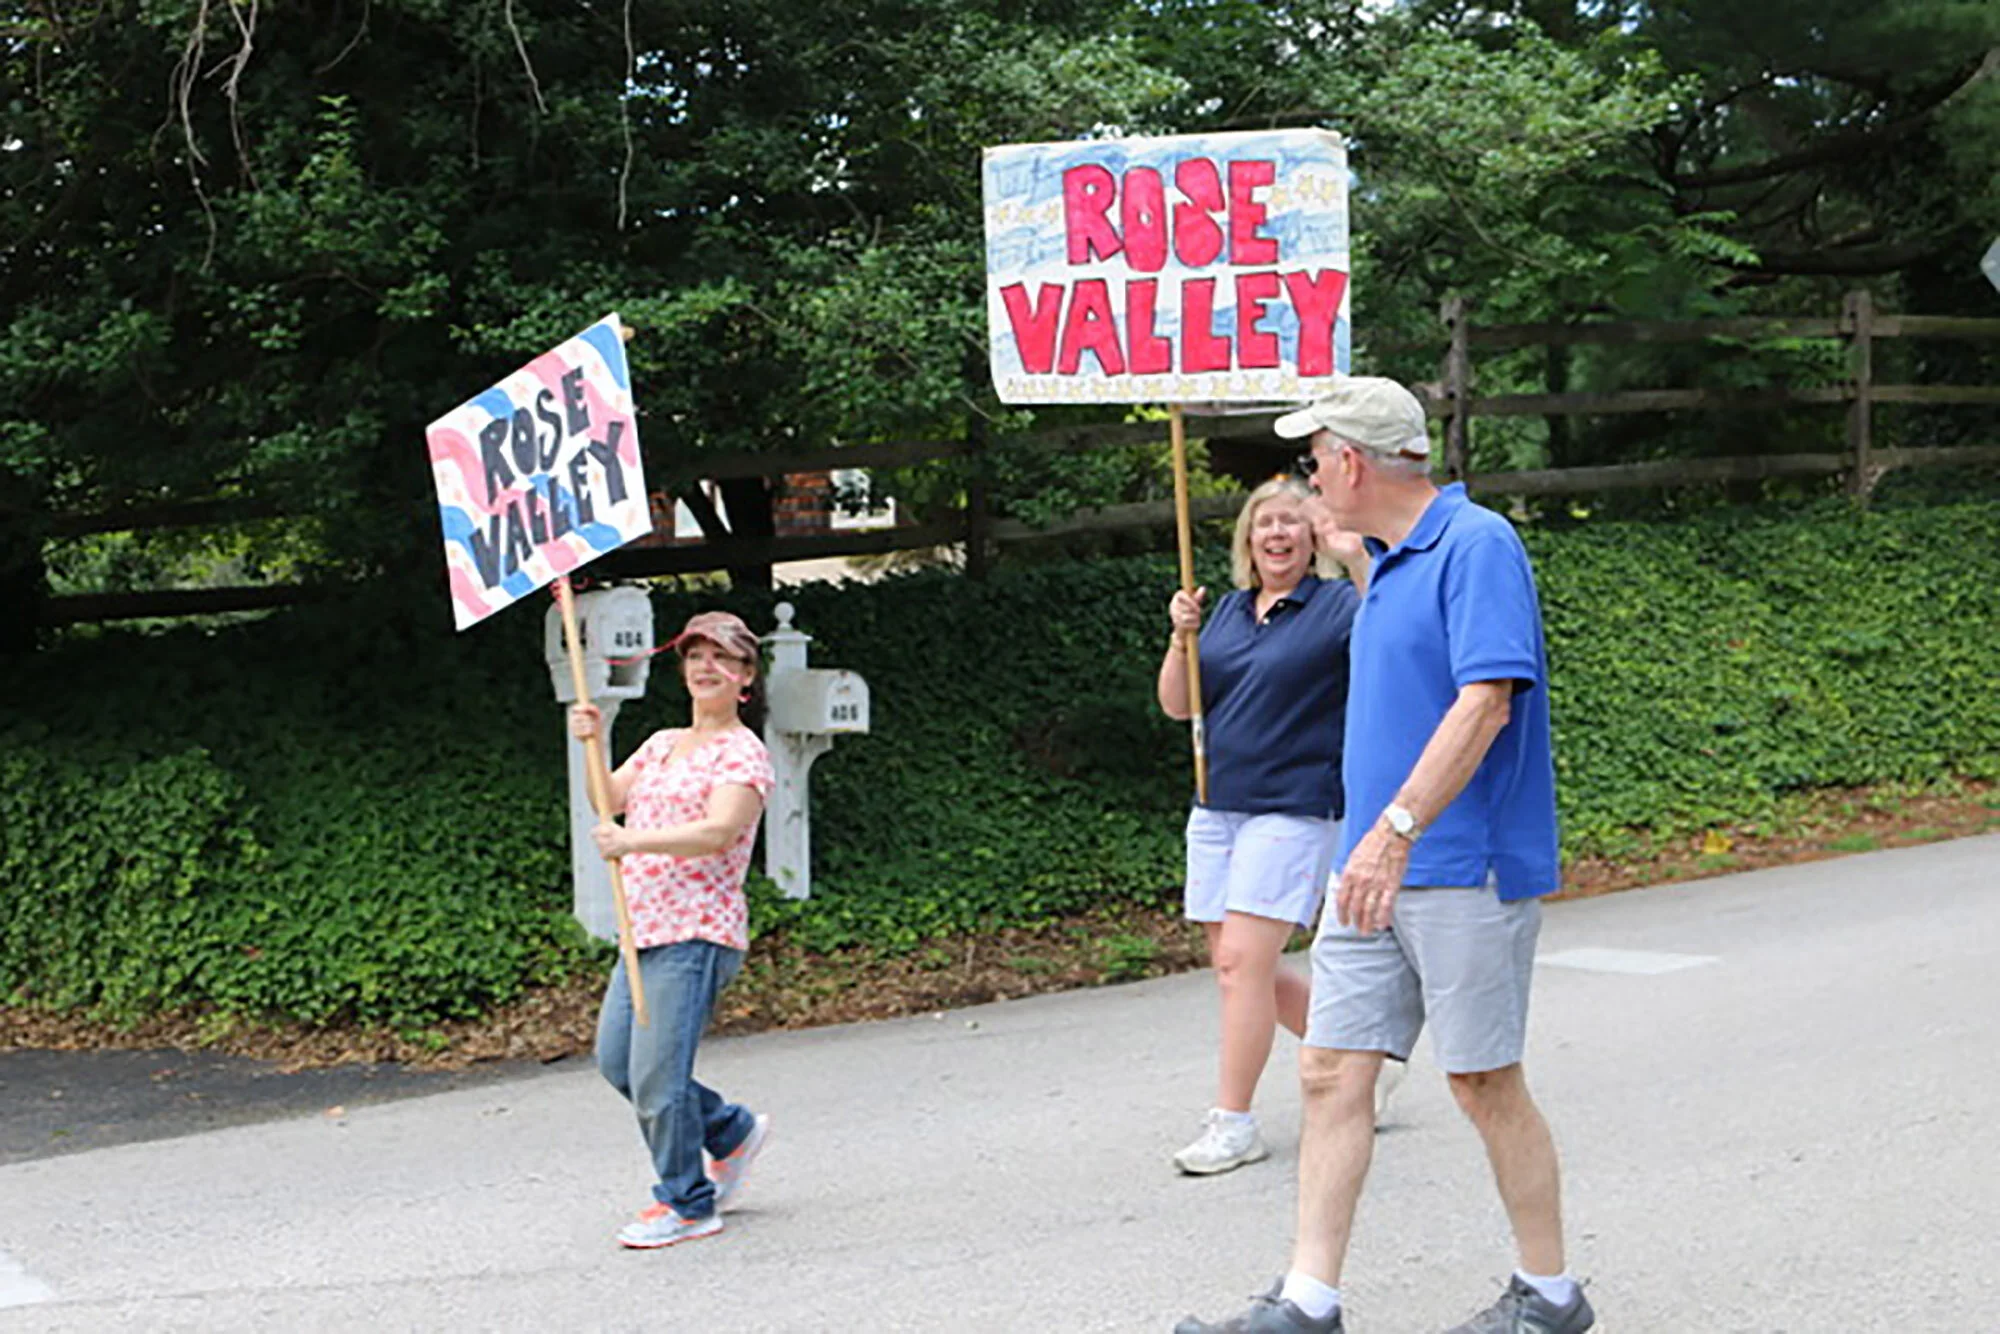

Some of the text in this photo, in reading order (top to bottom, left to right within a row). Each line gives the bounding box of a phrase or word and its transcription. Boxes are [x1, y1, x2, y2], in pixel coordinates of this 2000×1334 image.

[1062, 157, 1279, 272] ROSE
[1000, 268, 1349, 376] VALLEY
[479, 365, 591, 507] ROSE
[468, 420, 629, 590] VALLEY
